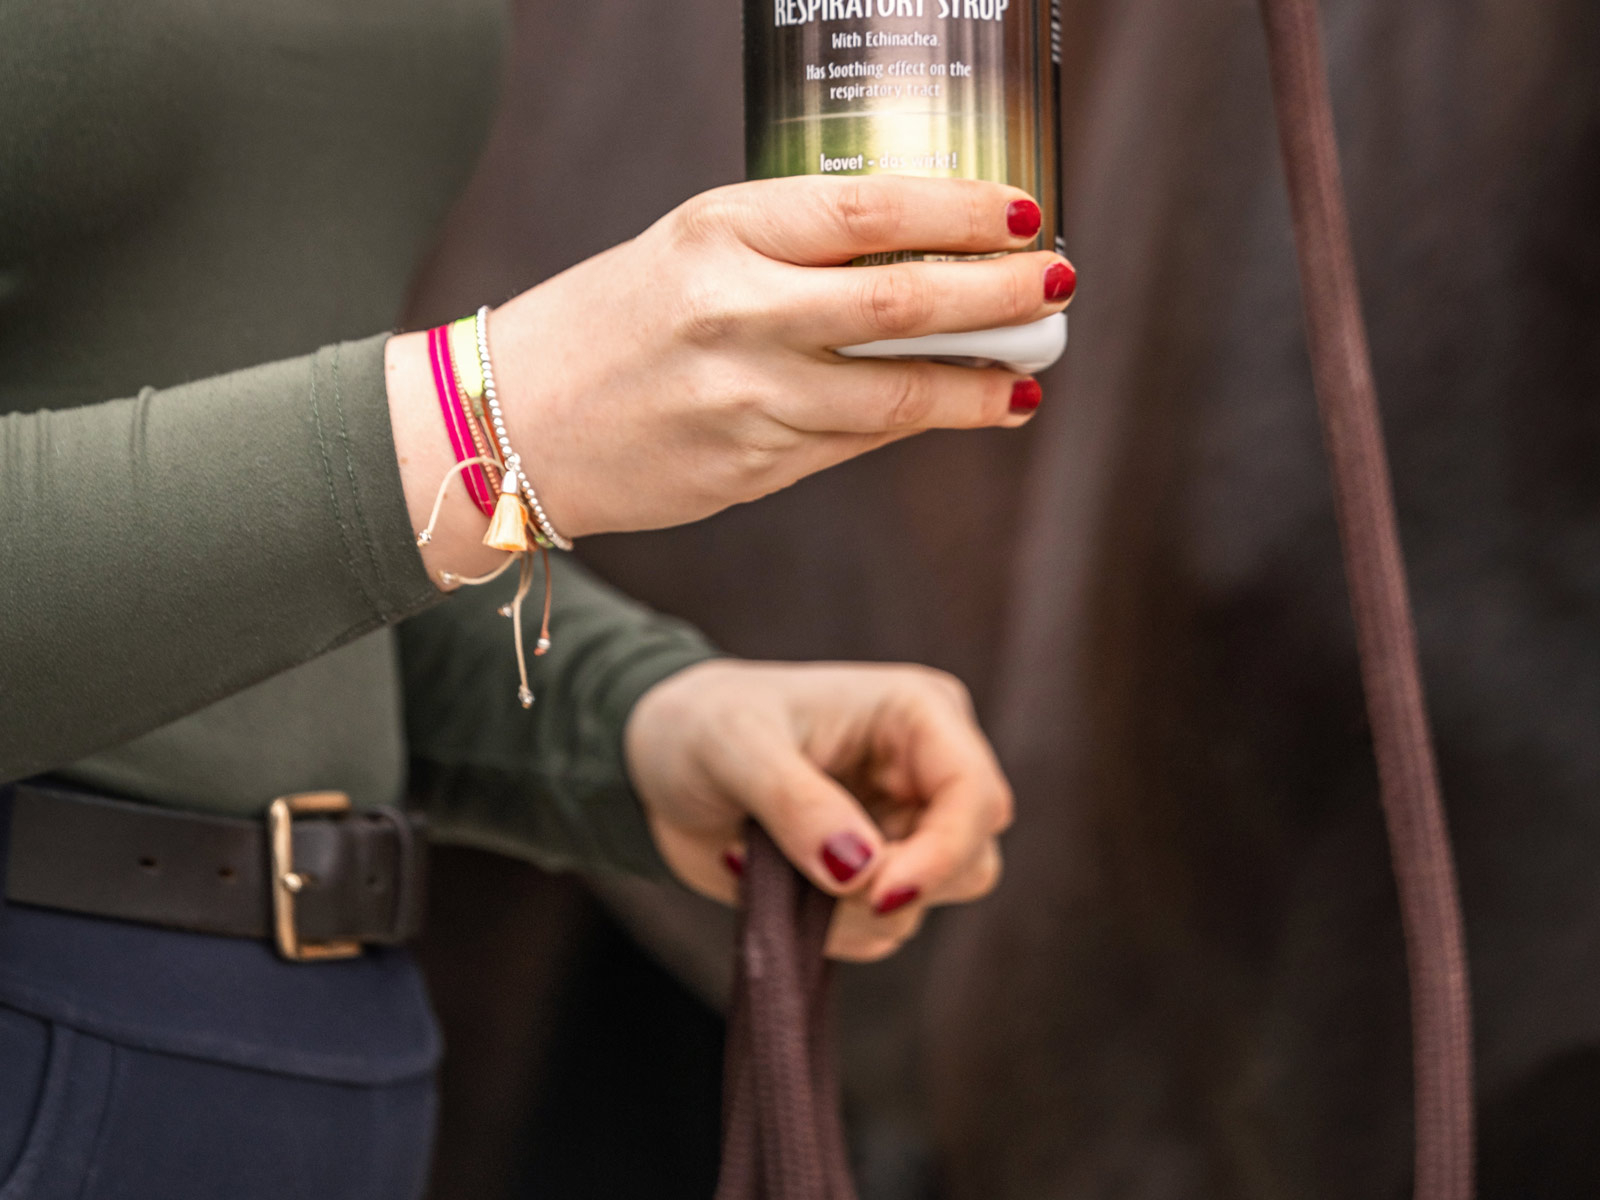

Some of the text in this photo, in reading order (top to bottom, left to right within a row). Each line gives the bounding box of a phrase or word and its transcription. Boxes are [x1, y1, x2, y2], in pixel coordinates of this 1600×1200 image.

[831, 32, 861, 50] With
[806, 60, 973, 80] Has Soothing effect on the
[830, 83, 941, 101] respiratory tract
[820, 152, 863, 171] leovet
